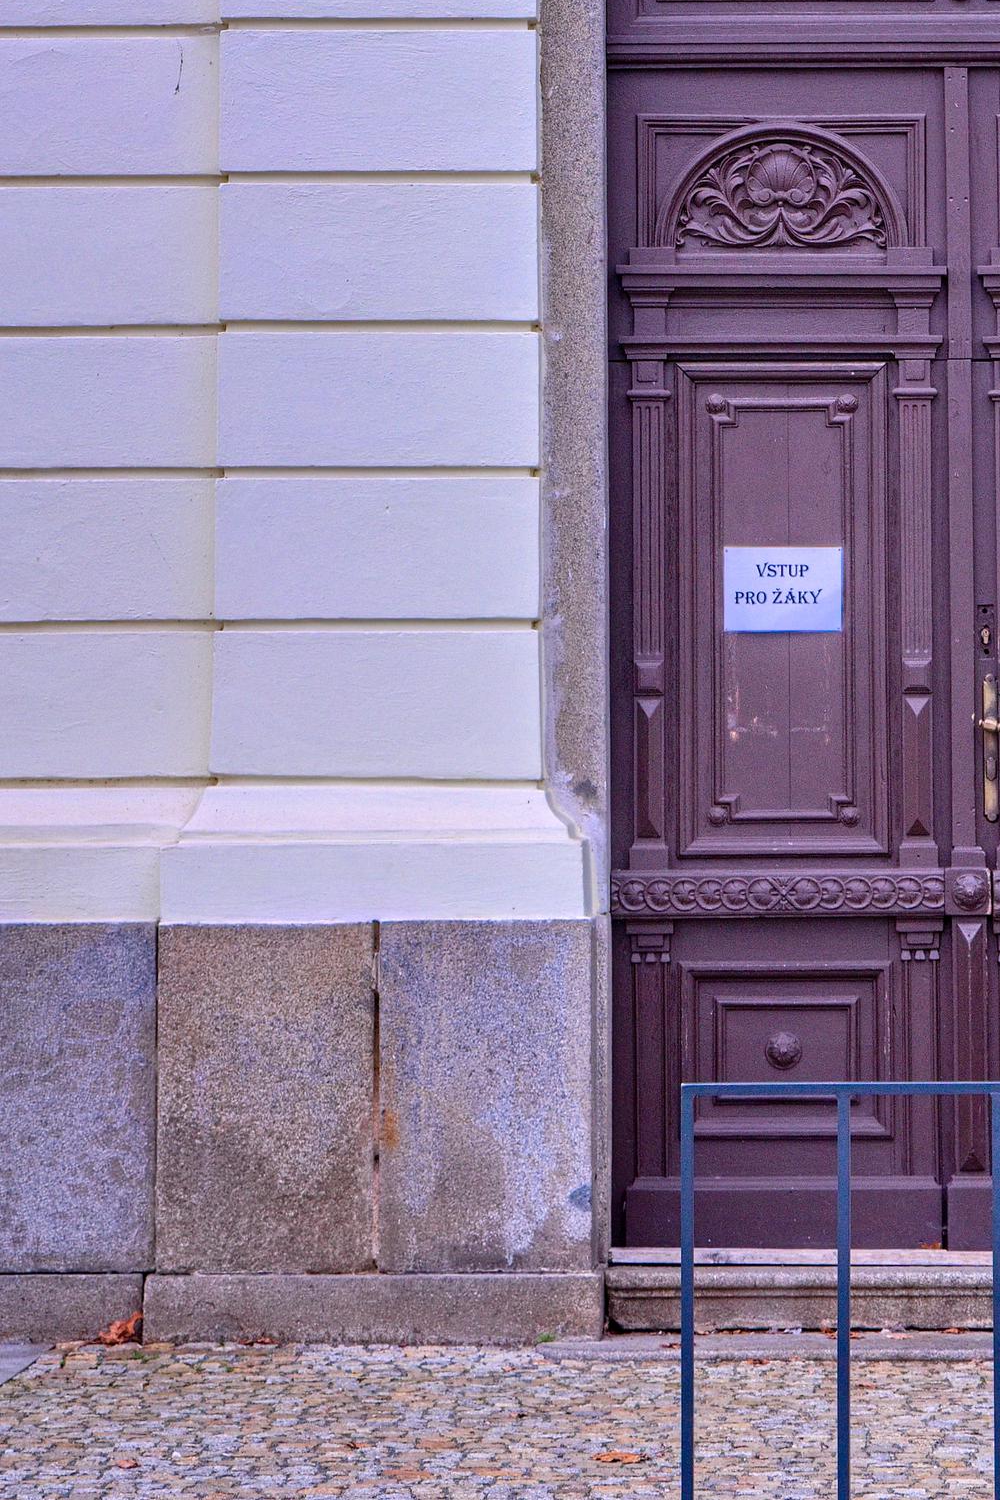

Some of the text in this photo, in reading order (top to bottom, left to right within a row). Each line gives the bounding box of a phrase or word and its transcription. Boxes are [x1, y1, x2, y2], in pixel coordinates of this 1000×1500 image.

[756, 562, 809, 578] VSTUP
[735, 587, 823, 605] PRO ŽÁKY
